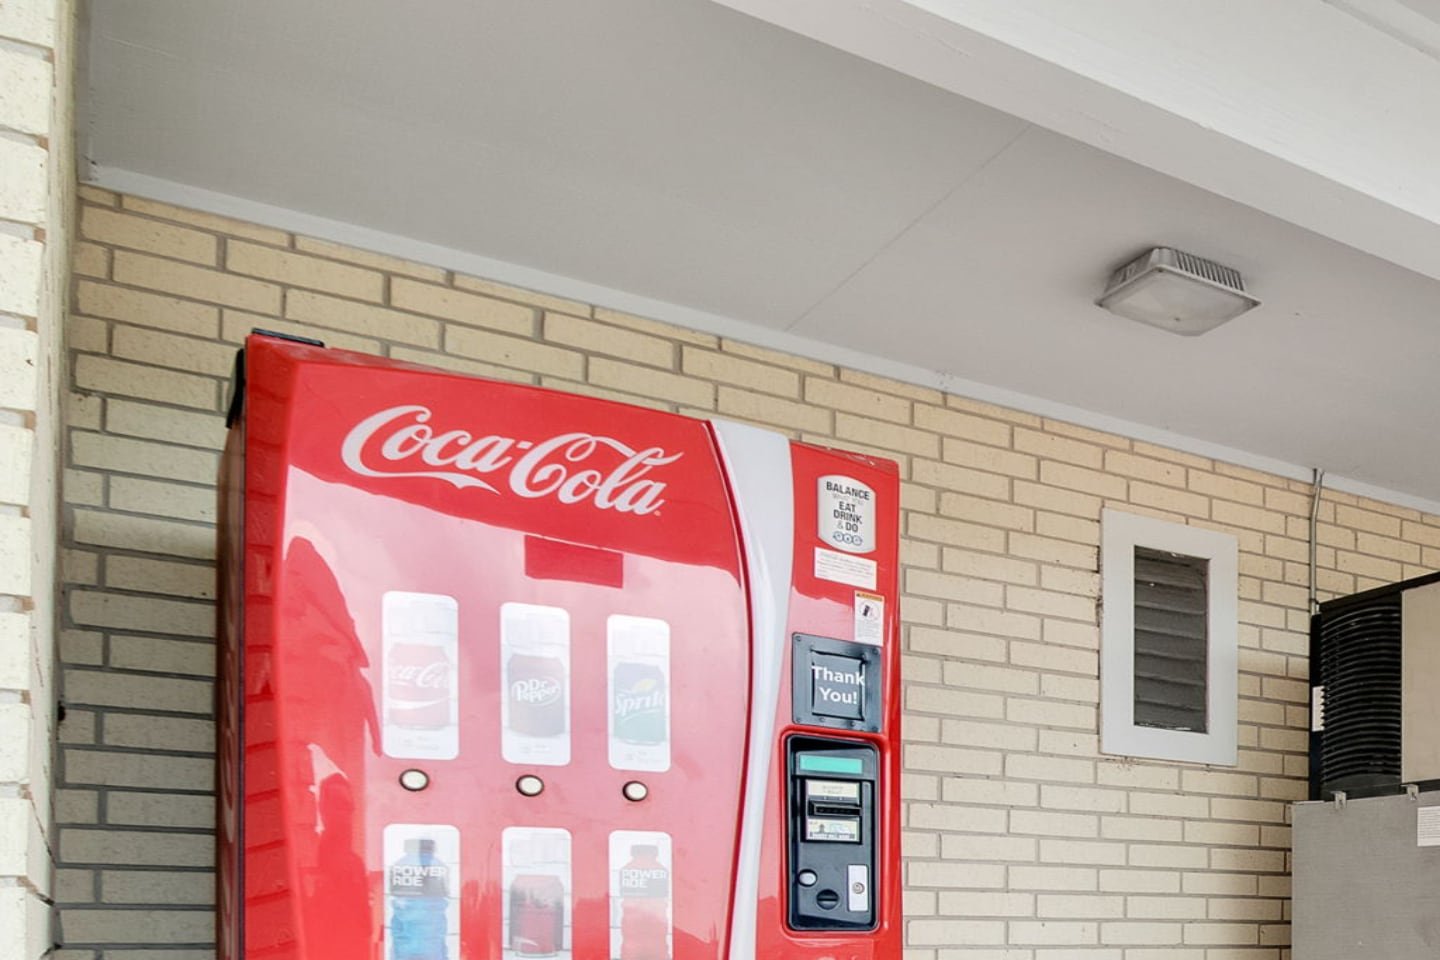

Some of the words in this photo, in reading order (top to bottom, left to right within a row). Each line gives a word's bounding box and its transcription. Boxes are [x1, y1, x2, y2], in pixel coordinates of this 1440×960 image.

[341, 405, 684, 516] Coca-Cola
[826, 481, 870, 501] BALANCE
[838, 500, 856, 513] EAT
[833, 509, 863, 525] DRINK
[845, 522, 859, 533] DO
[811, 665, 865, 686] Thank
[819, 686, 858, 705] You!
[391, 865, 447, 878] POWER
